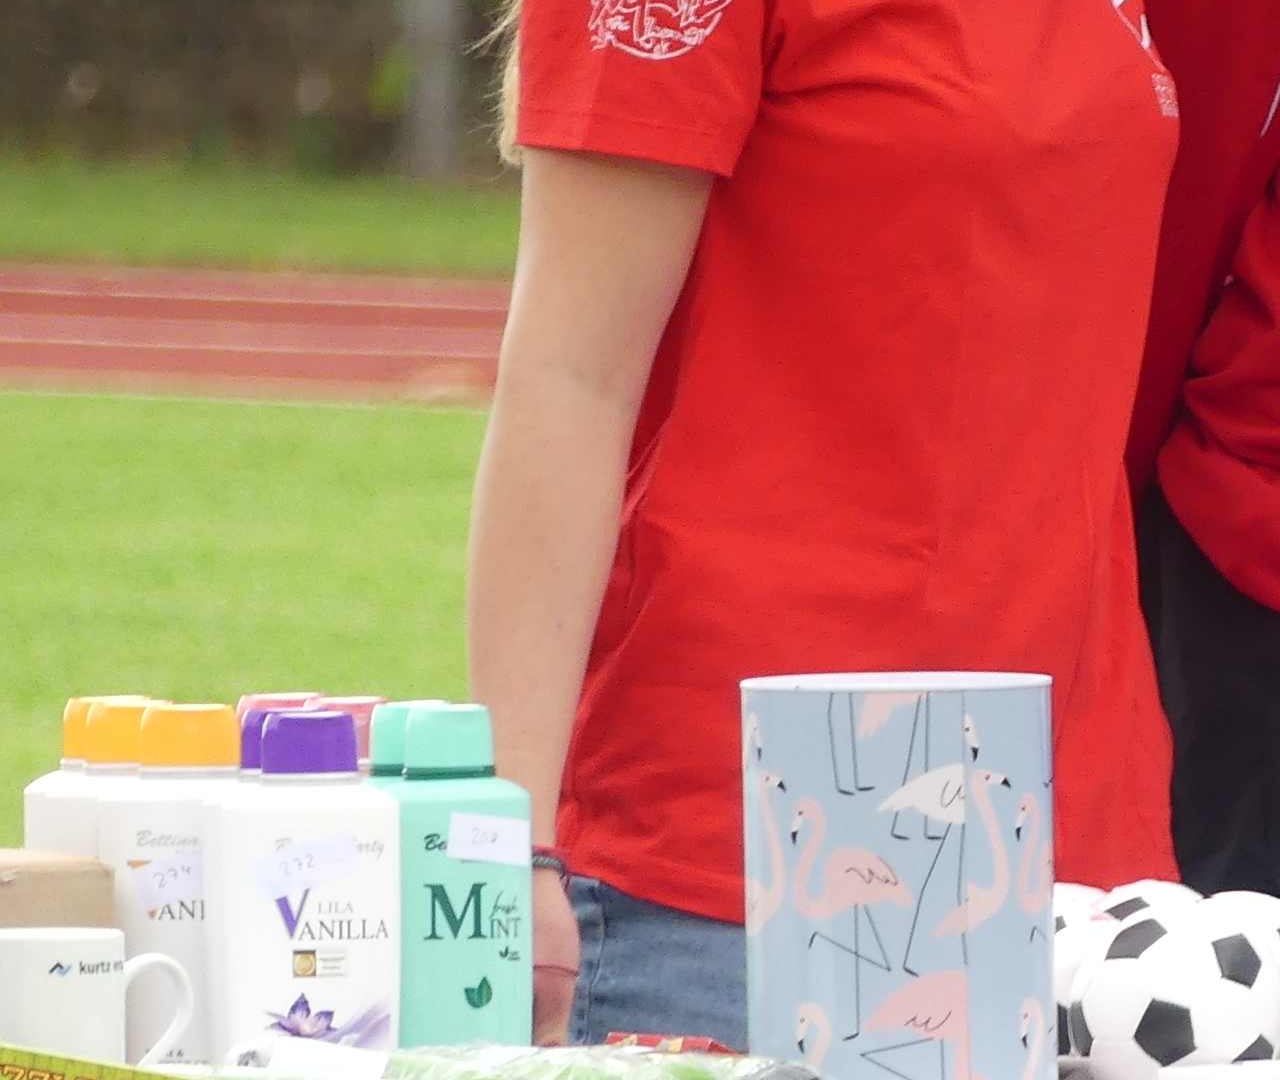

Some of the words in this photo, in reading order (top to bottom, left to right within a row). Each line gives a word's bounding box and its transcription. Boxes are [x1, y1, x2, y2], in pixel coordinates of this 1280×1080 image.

[275, 887, 390, 941] VANILLA
[317, 901, 355, 916] LILA
[422, 881, 522, 941] MINT
